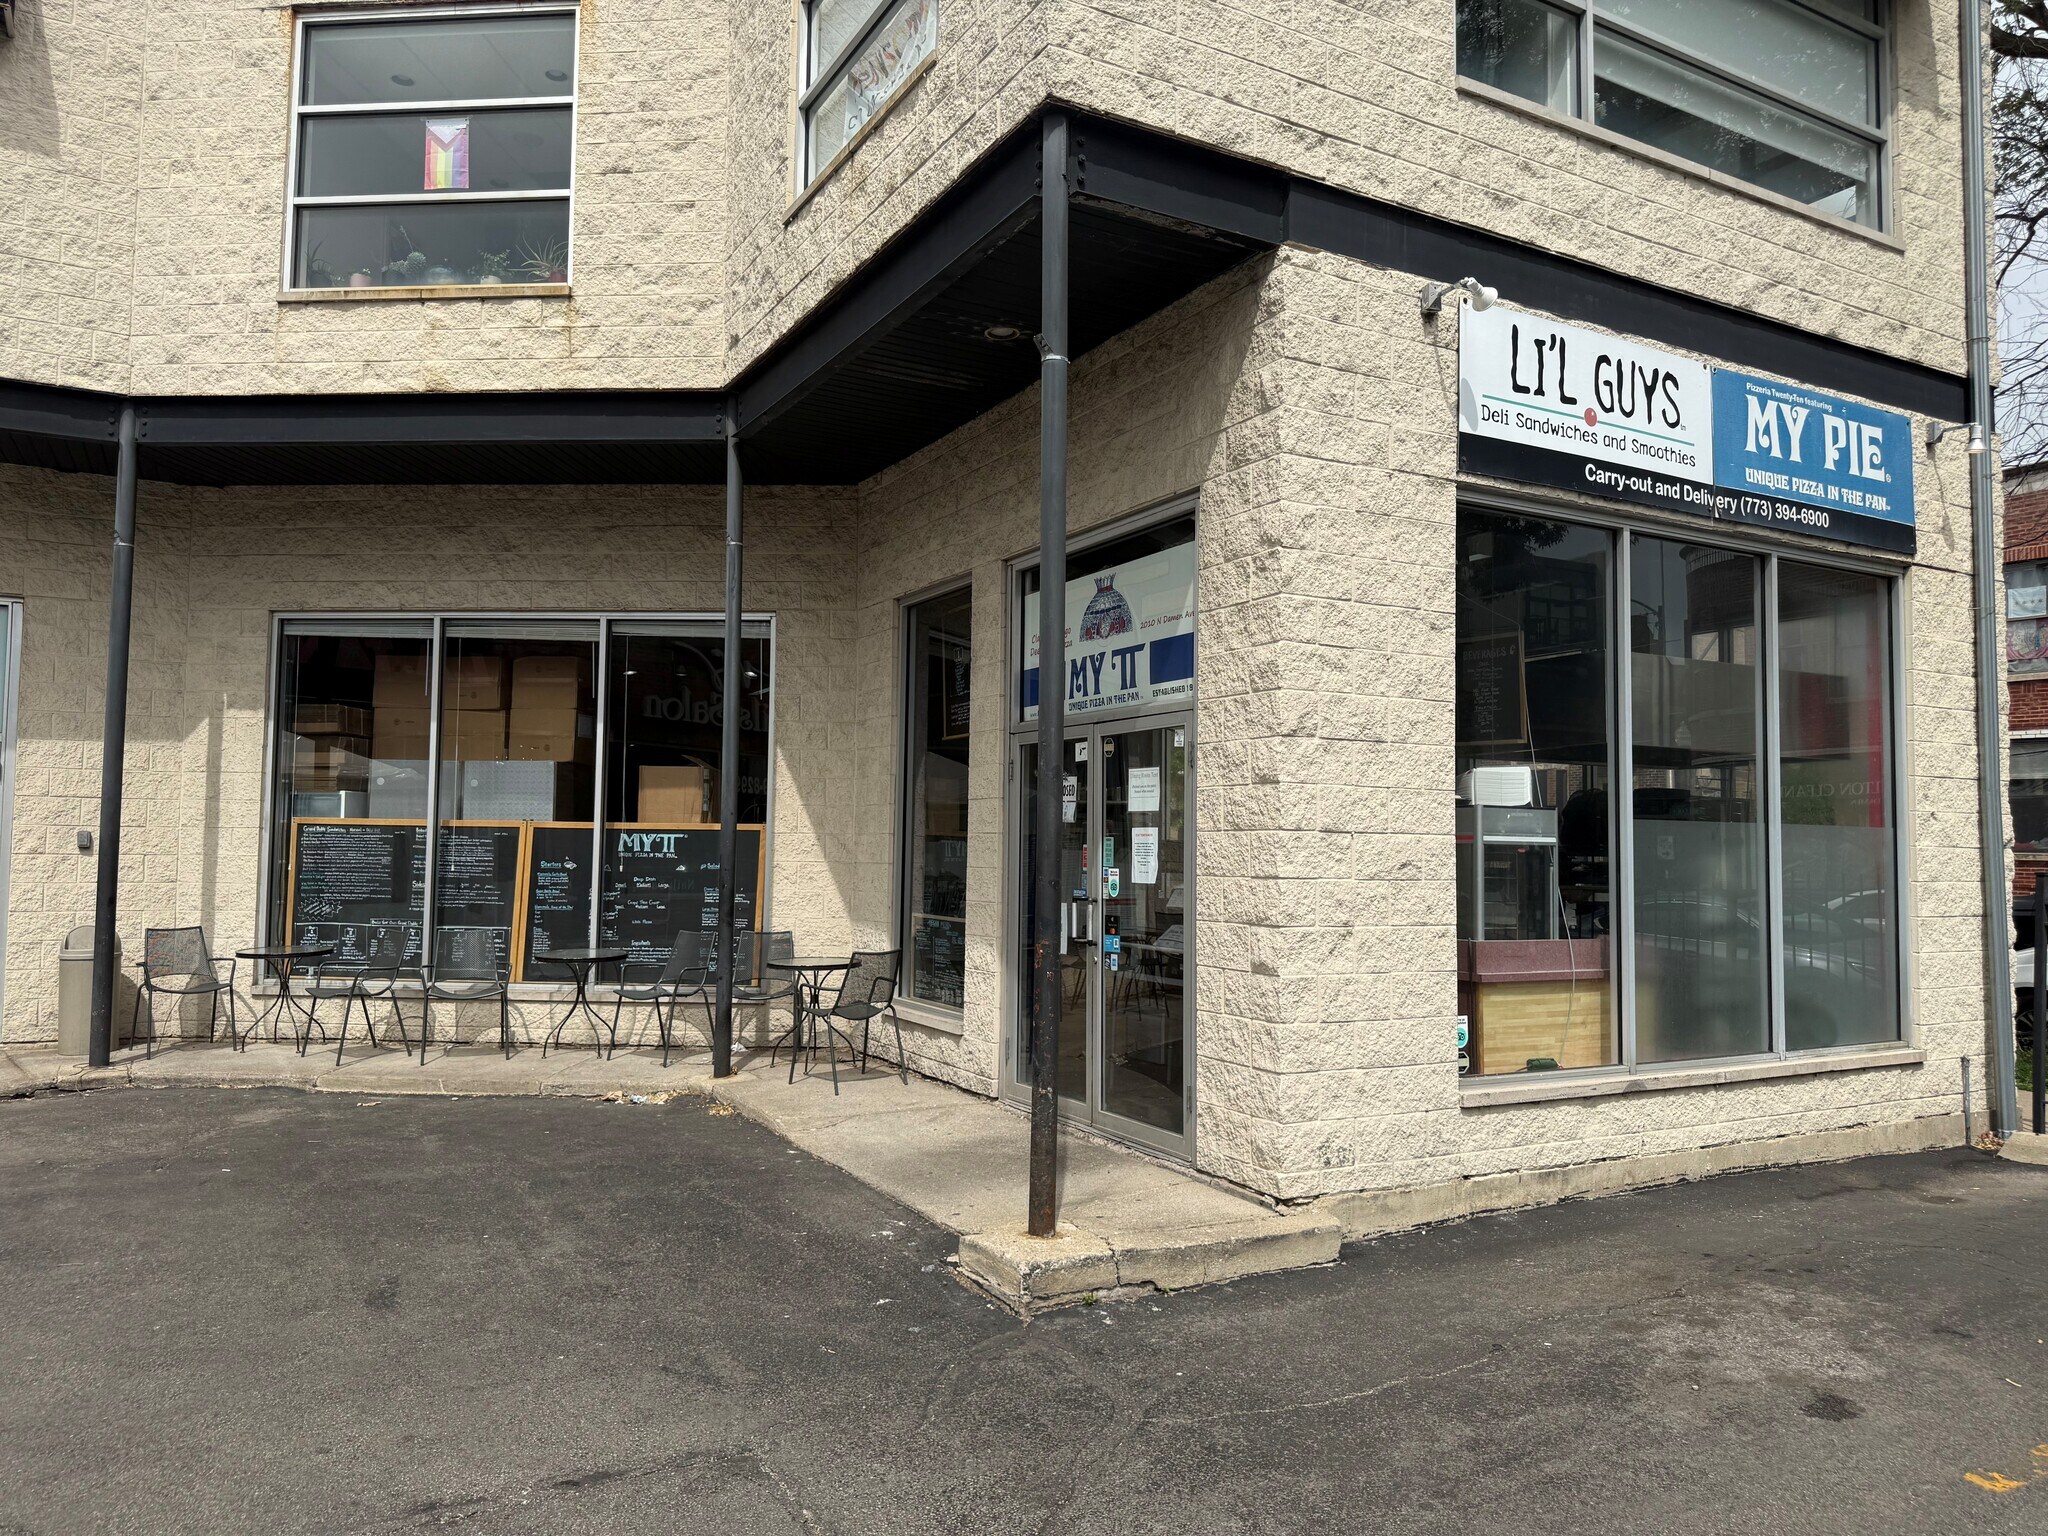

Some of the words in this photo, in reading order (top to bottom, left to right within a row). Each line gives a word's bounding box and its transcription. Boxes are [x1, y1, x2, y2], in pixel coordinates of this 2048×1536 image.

[1510, 324, 1578, 406] LI'L
[1594, 354, 1682, 430] GUYS
[1746, 382, 1770, 396] Pizzeria
[1772, 388, 1804, 403] Twenty-Ten
[1804, 396, 1832, 412] featuring
[1481, 404, 1510, 426] Deli
[1516, 412, 1598, 446] Sandwiches
[1603, 434, 1628, 452] and
[1631, 438, 1696, 468] Smoothies
[1744, 394, 1810, 462] MY
[1823, 412, 1886, 482] PIE
[1585, 464, 1653, 498] Carry-out
[1656, 480, 1680, 500] and
[1684, 486, 1738, 516] Delivery
[1740, 496, 1772, 522] (773)
[1775, 502, 1830, 528] 394-6900
[1744, 466, 1790, 492] UNIQUE
[1791, 477, 1826, 499] PIZZA
[1827, 485, 1840, 502] IN
[1841, 488, 1864, 507] THE
[1140, 619, 1156, 630] 2010
[1157, 616, 1162, 626] N
[1068, 652, 1106, 700] MY
[1152, 684, 1186, 698] ESTABLISHED
[1068, 701, 1088, 712] UNIQUE
[1089, 699, 1106, 708] PIZZA
[1106, 697, 1113, 706] IN
[1114, 694, 1126, 704] THE
[1063, 784, 1075, 796] OSED
[618, 834, 656, 852] MY
